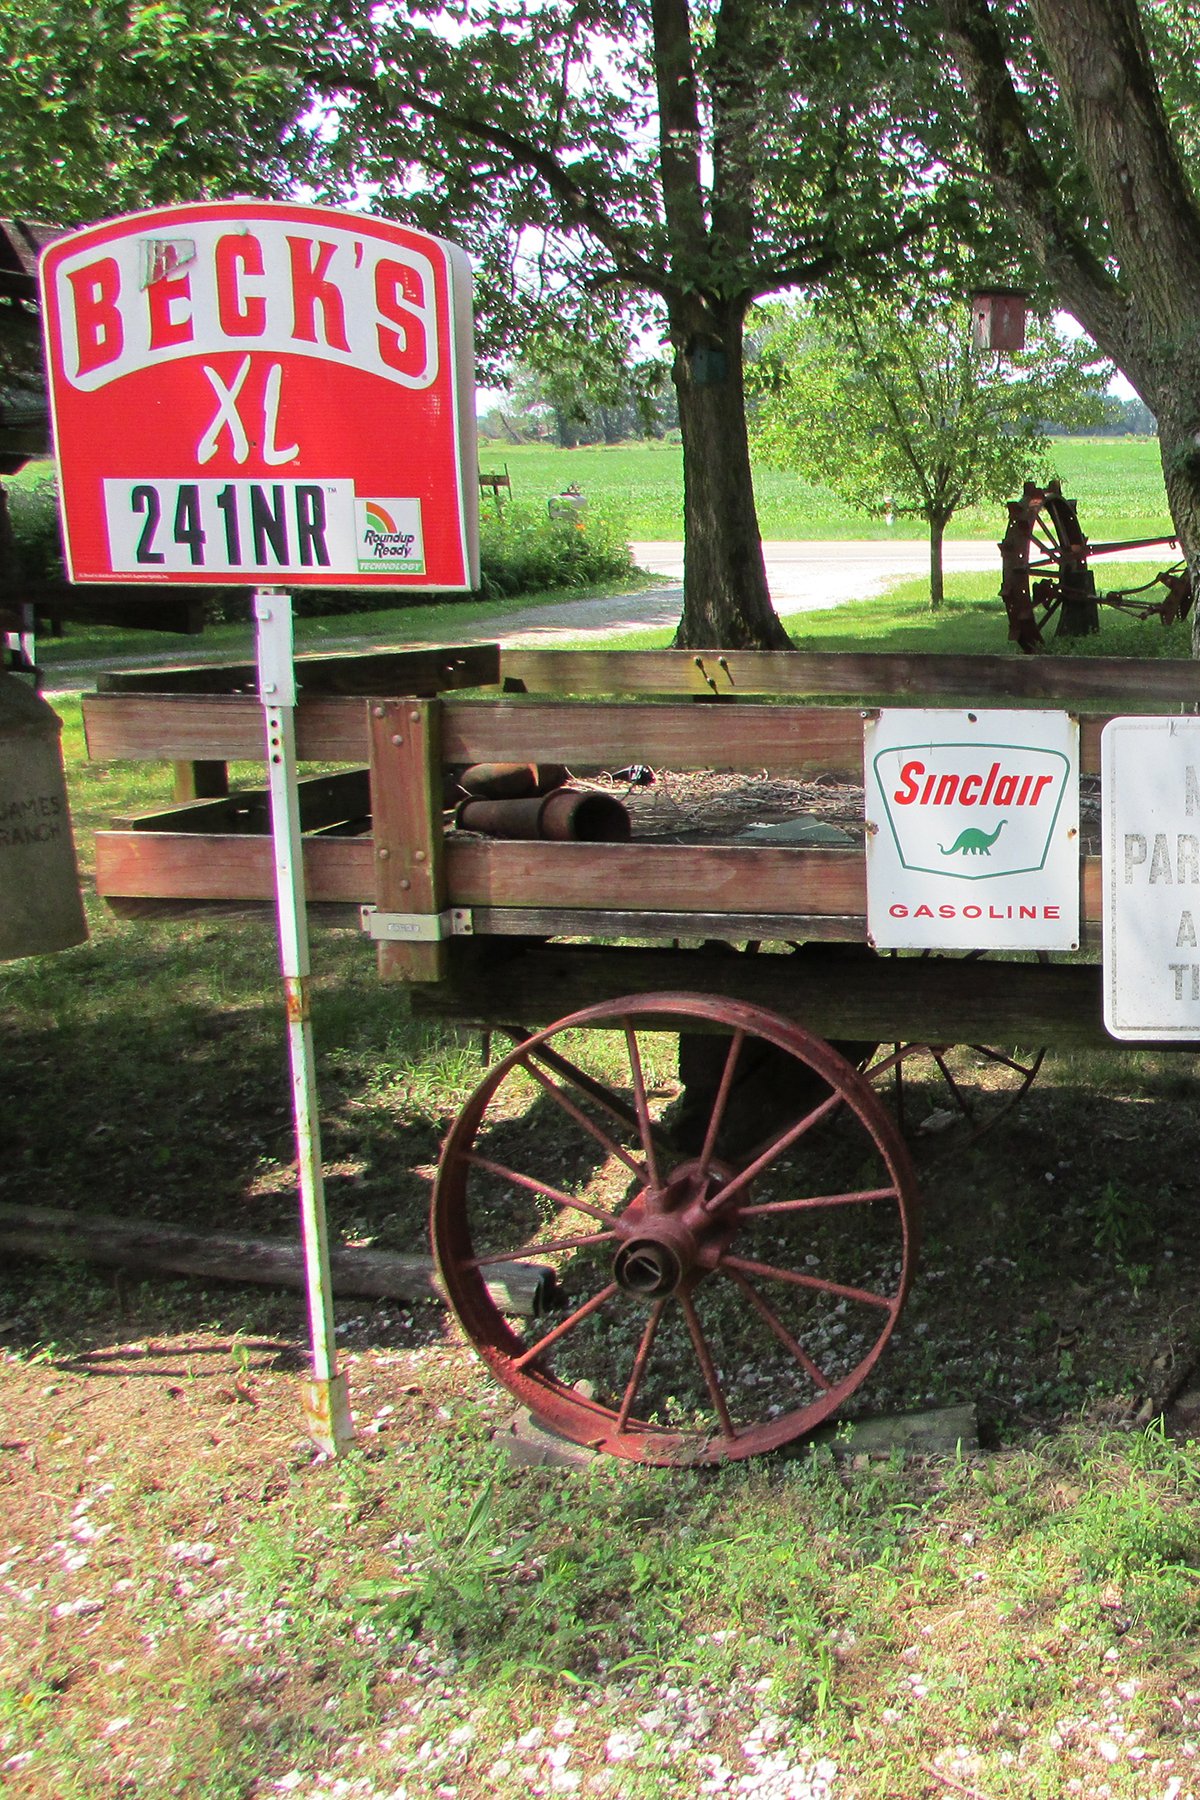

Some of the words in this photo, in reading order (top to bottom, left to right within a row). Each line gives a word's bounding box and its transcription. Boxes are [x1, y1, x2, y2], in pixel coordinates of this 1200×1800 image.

[65, 233, 427, 378] BECK'S
[198, 354, 300, 466] XL
[131, 484, 331, 567] 241NR
[364, 529, 415, 546] Roundup
[373, 542, 412, 558] Ready
[359, 562, 421, 571] TECHNOLOGY
[893, 760, 1053, 807] Sinclair
[889, 903, 1061, 919] GASOLINE
